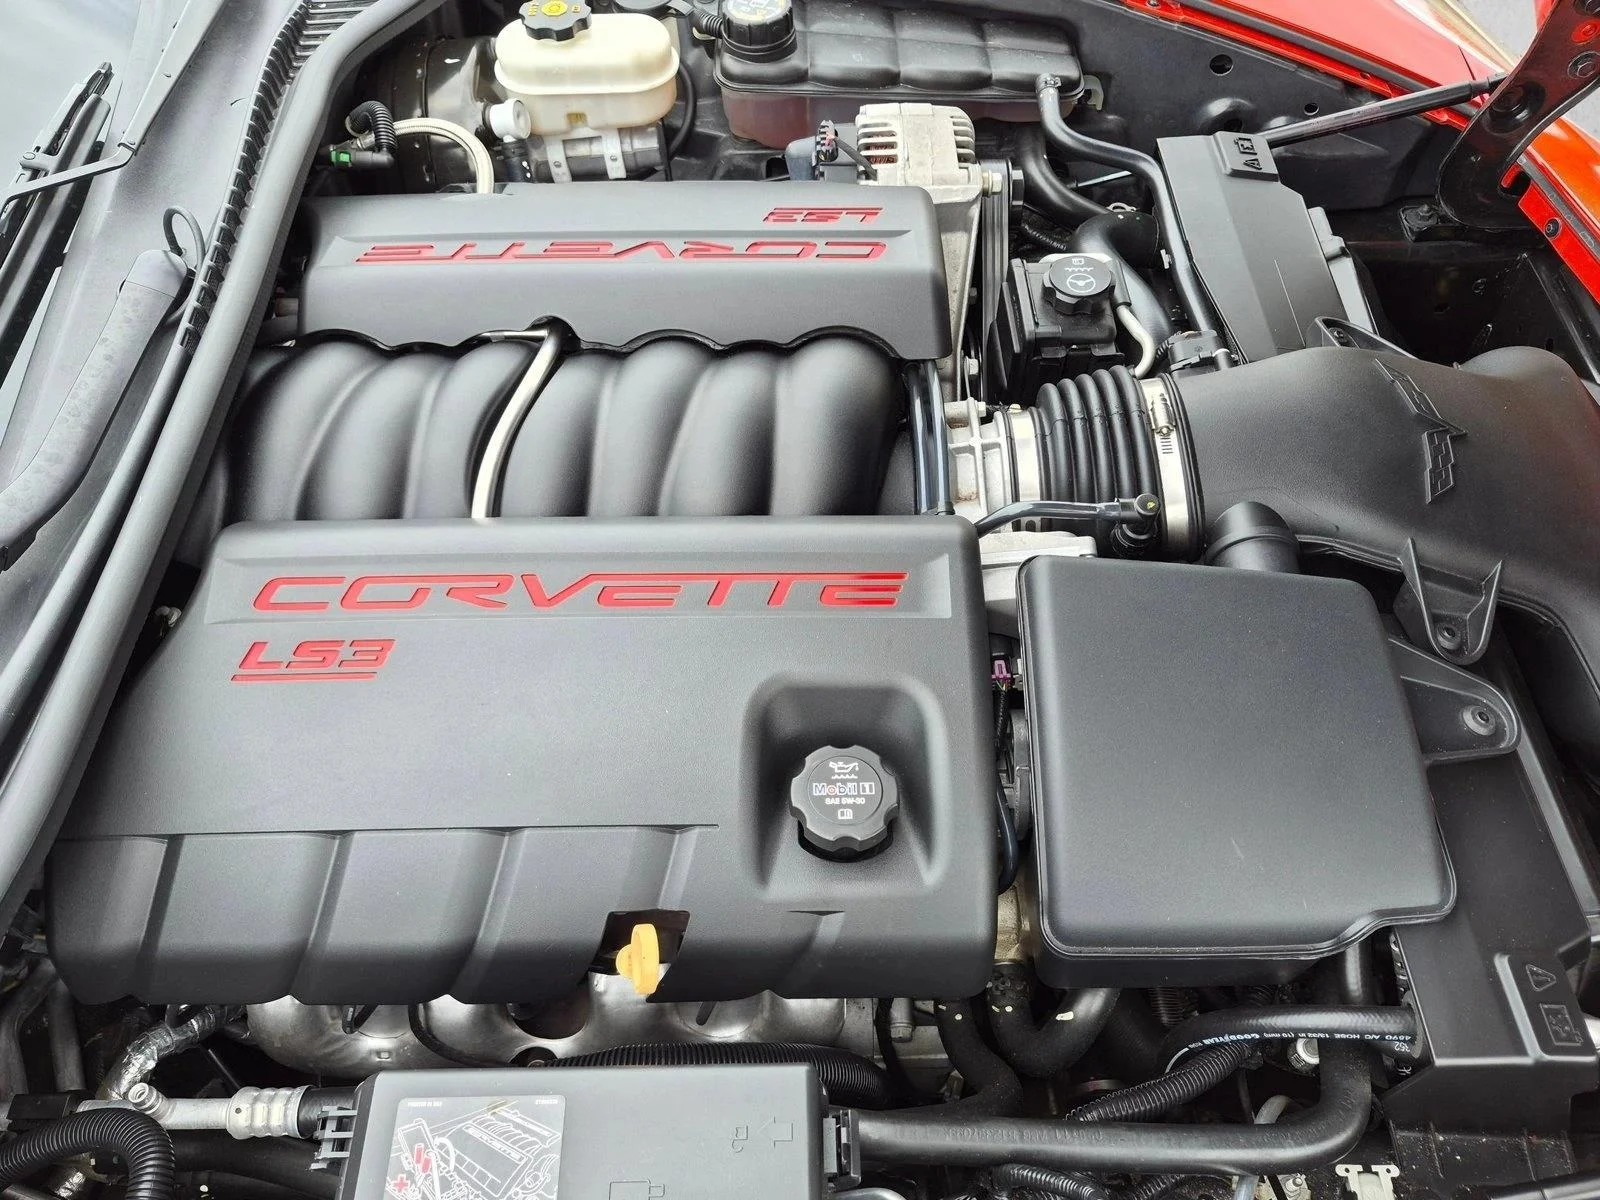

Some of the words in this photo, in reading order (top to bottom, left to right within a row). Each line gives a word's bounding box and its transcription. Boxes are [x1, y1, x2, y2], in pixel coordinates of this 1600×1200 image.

[763, 206, 883, 224] LS3
[356, 240, 888, 263] CORVETTE
[252, 571, 910, 613] CORVETTE
[238, 639, 397, 672] LS3
[813, 782, 858, 796] Mobil
[825, 797, 840, 805] SAE
[841, 797, 866, 805] 5W-30
[1202, 1032, 1260, 1045] GOODYEAR
